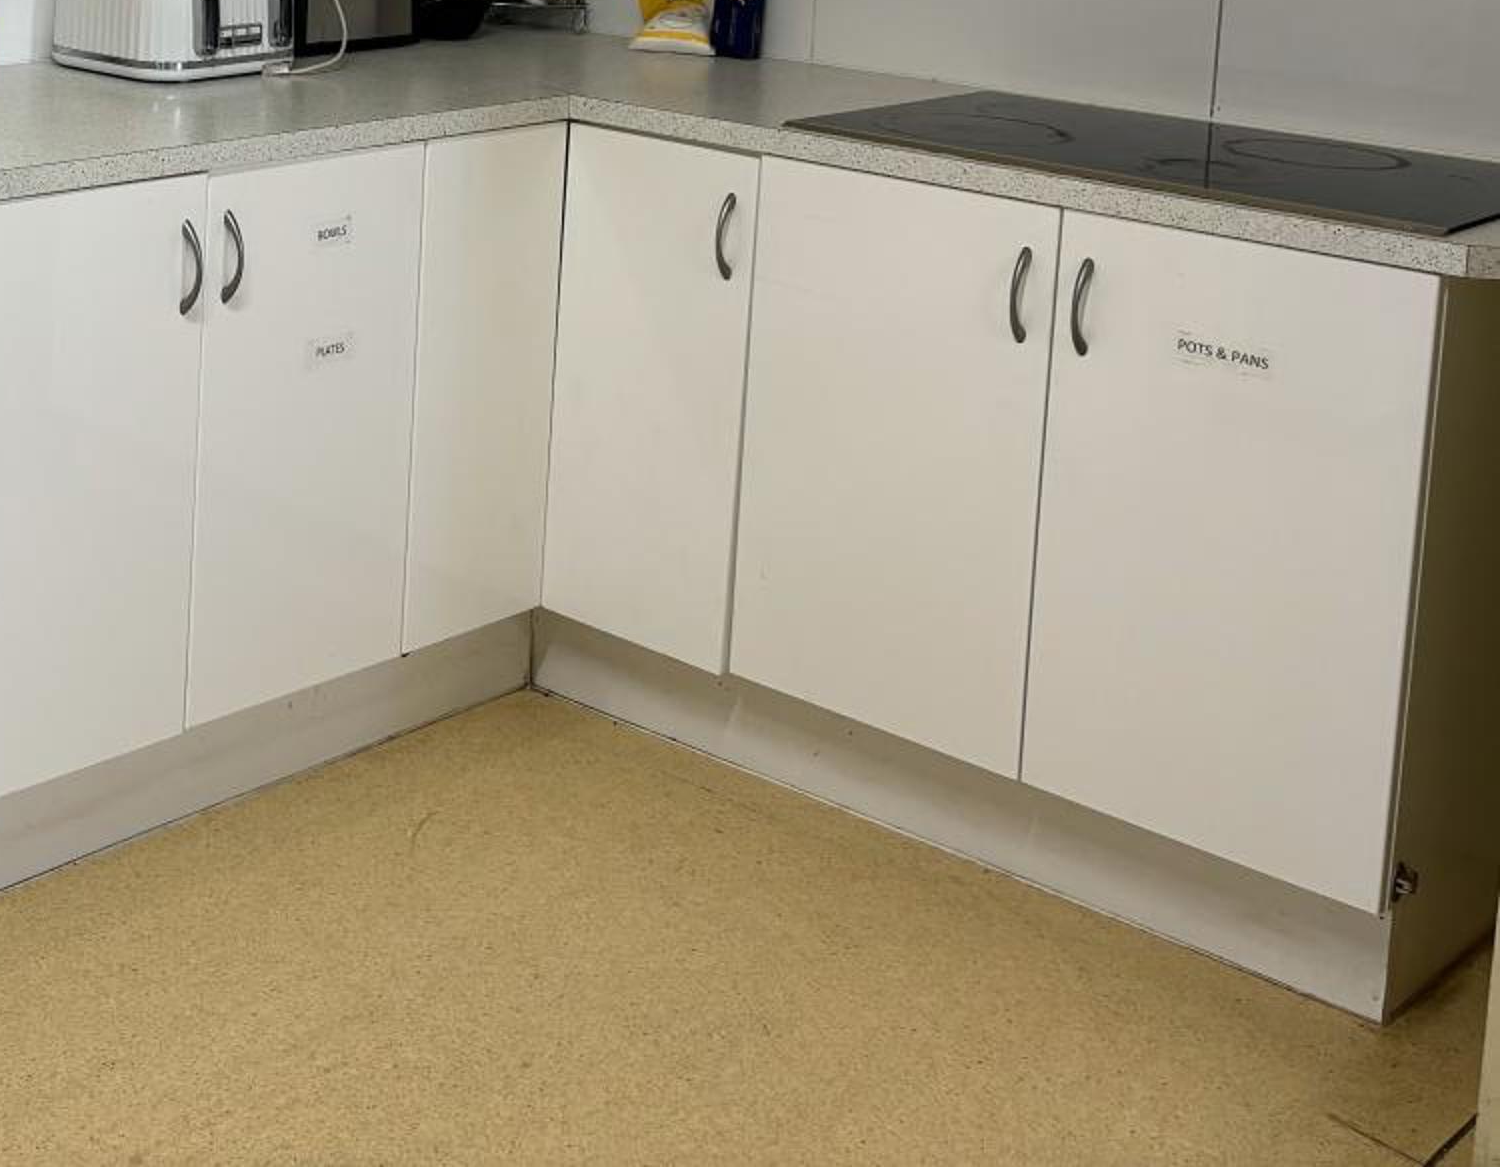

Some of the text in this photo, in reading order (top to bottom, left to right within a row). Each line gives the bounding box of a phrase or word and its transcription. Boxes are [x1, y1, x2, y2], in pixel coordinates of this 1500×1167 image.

[1177, 338, 1269, 369] POTS & PANS
